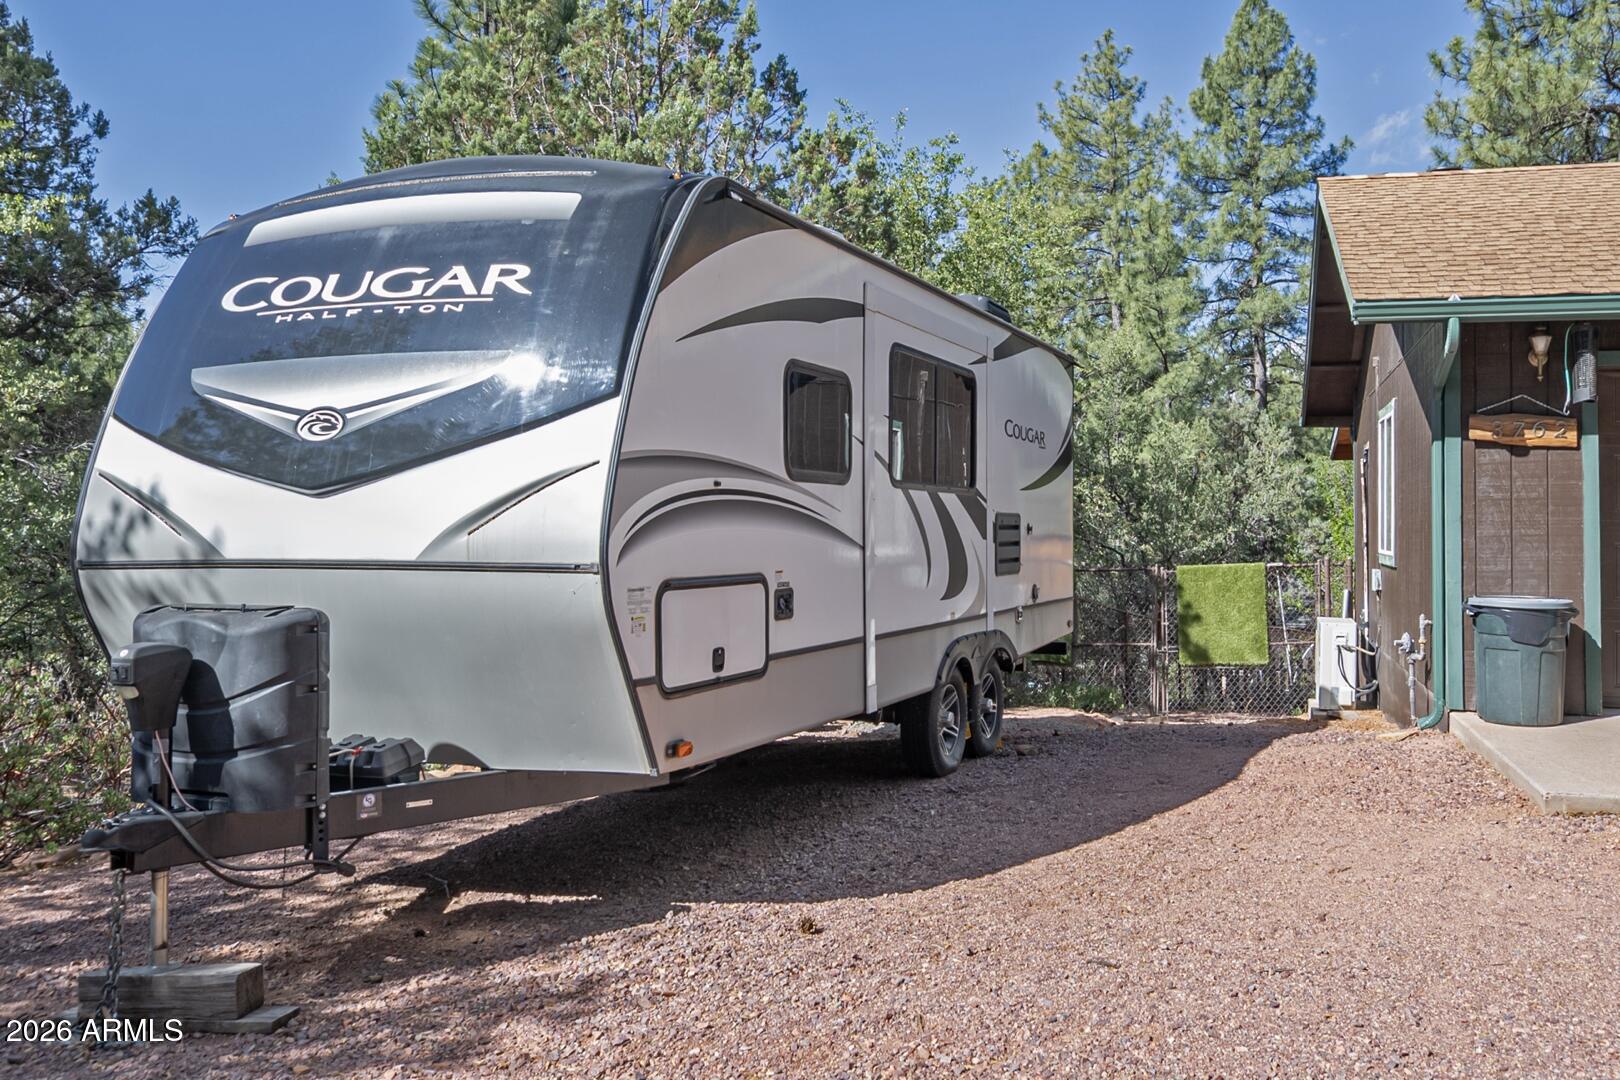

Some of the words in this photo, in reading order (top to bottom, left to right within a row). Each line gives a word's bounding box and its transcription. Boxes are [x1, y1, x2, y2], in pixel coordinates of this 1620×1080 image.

[221, 264, 533, 313] COUGAR
[275, 304, 464, 323] HALF-TON
[1004, 419, 1046, 446] COUGAR
[1491, 420, 1569, 439] 3762
